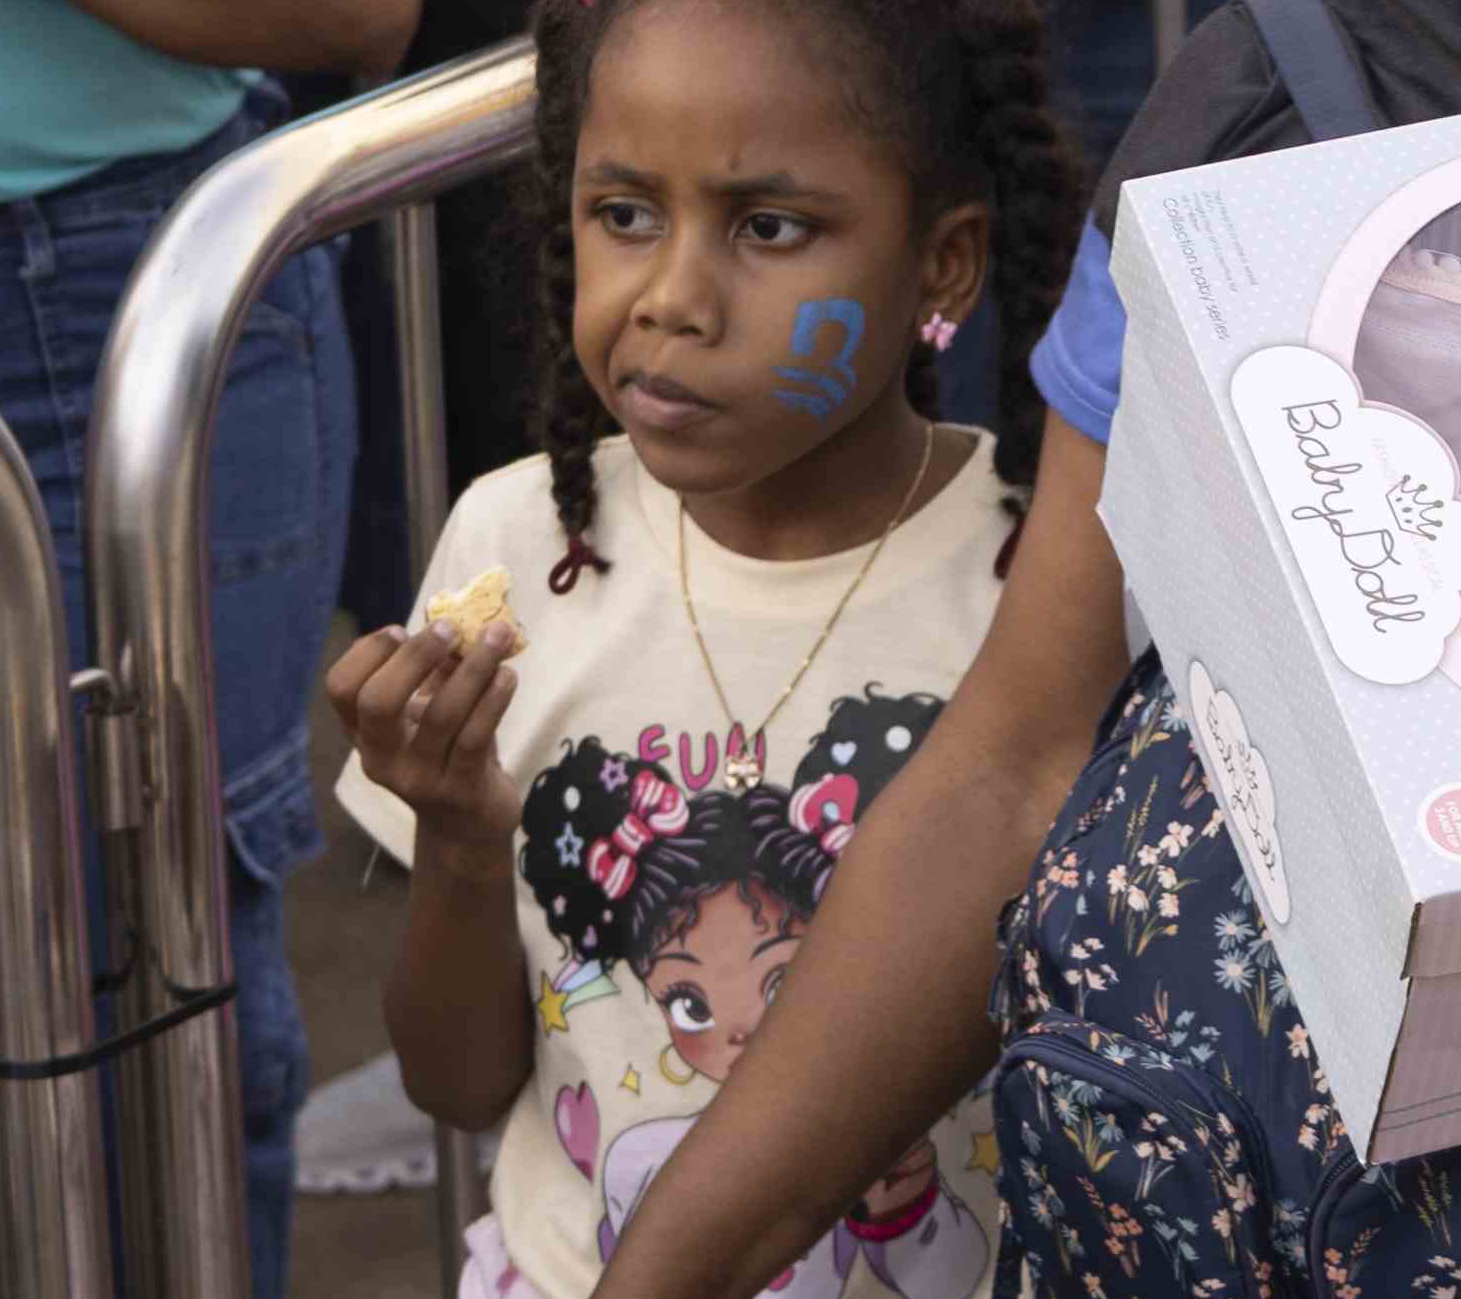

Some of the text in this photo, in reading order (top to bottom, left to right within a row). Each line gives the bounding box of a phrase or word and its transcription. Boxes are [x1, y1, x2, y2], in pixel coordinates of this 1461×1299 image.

[1162, 196, 1198, 268] Collection
[1189, 264, 1212, 302] baby
[1206, 304, 1231, 341] series
